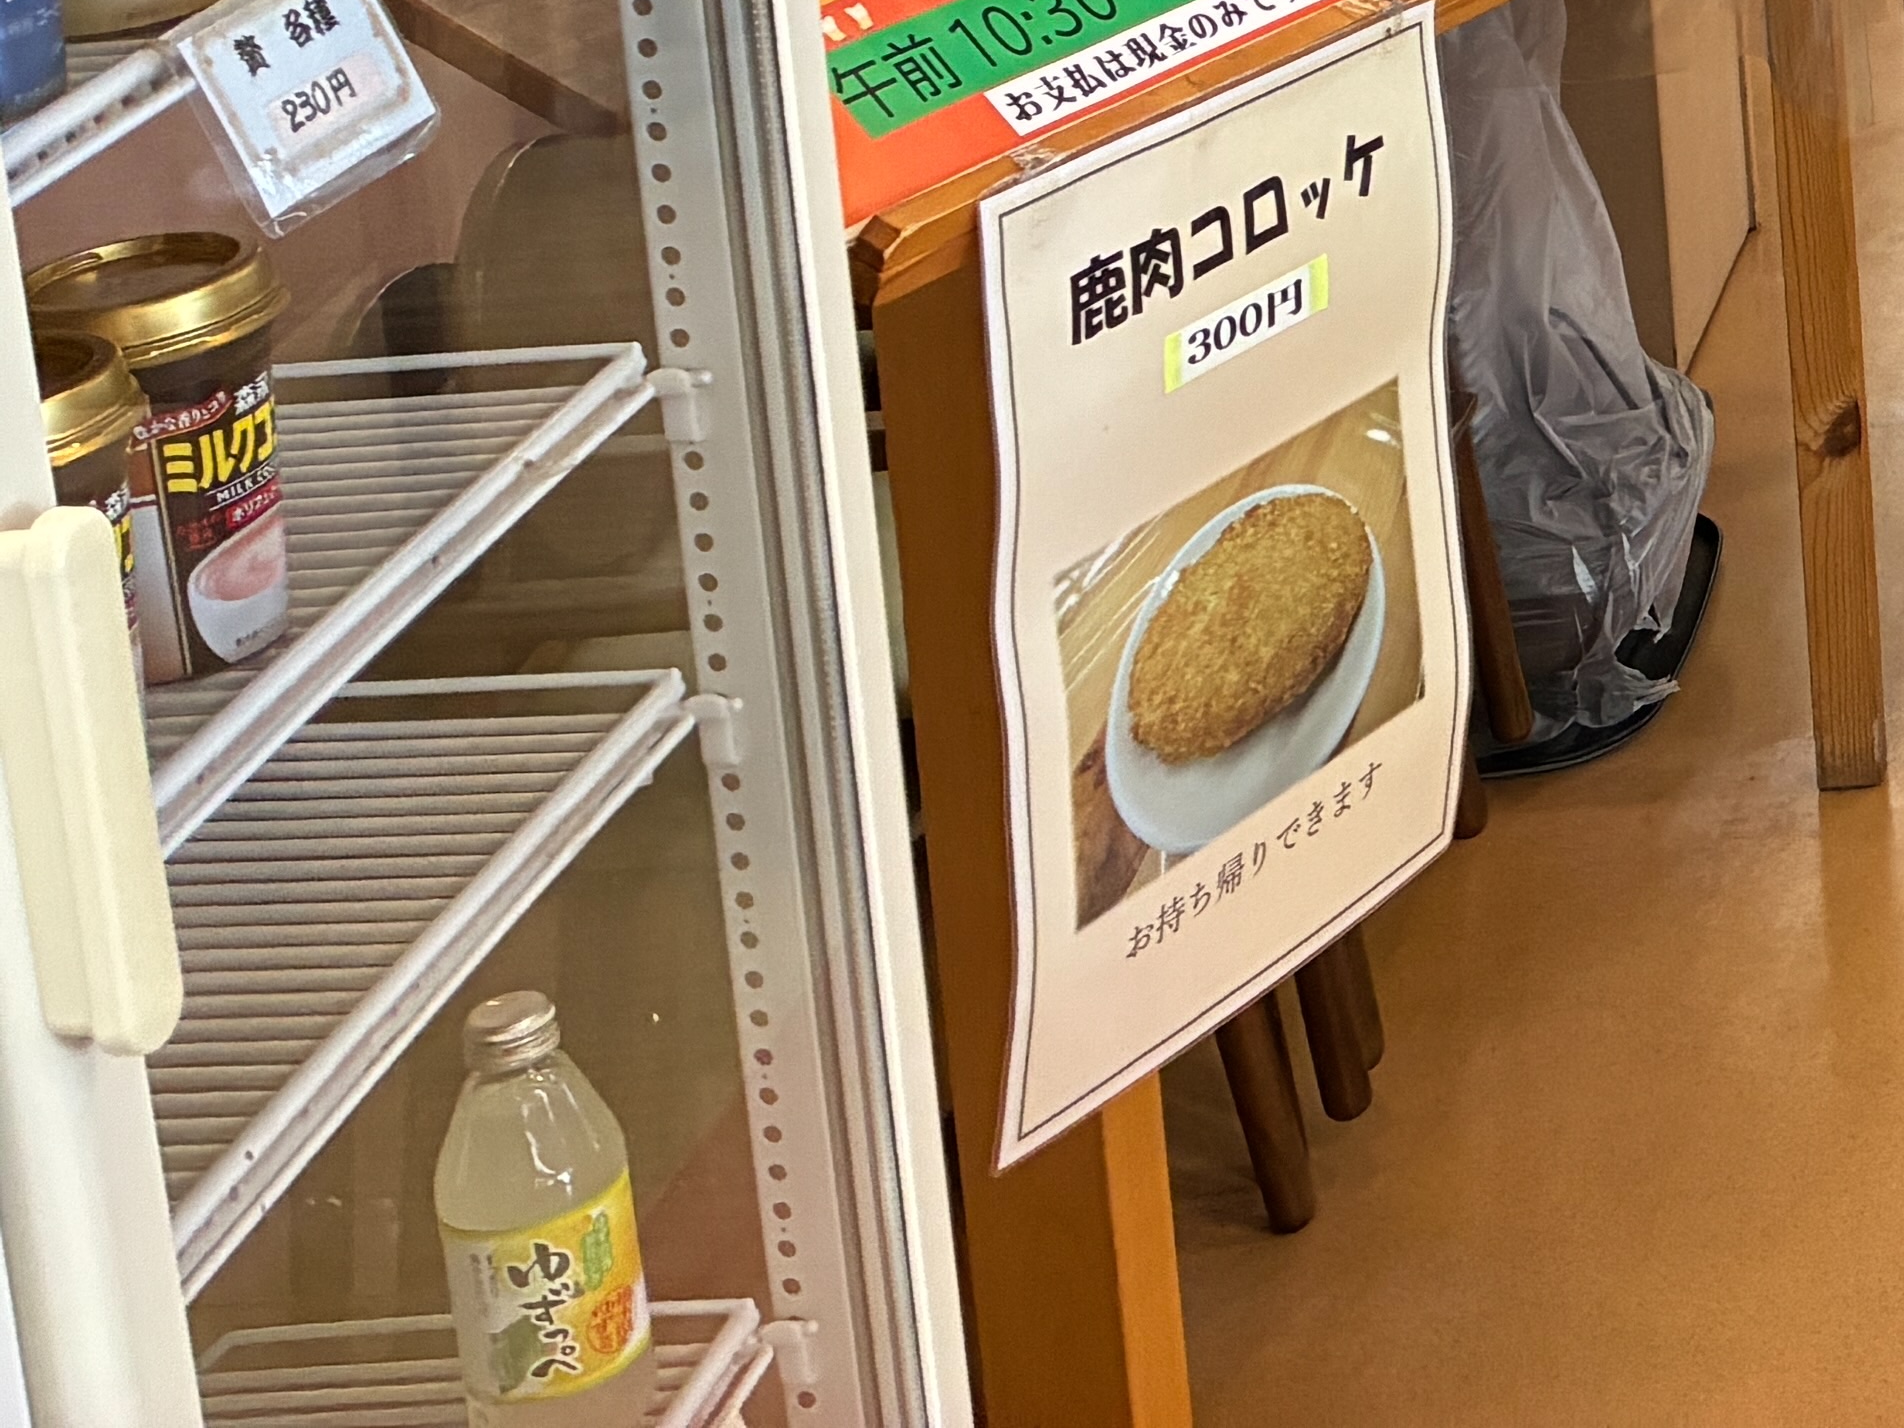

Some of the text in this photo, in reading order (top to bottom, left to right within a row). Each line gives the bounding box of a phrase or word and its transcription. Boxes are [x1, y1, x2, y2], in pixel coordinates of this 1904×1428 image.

[280, 72, 361, 134] 230円
[1070, 133, 1386, 348] 鹿肉コロッケ
[1185, 278, 1305, 372] 300円
[1126, 761, 1384, 960] お持ち帰りできます
[507, 1243, 577, 1378] ゆずっぺ
